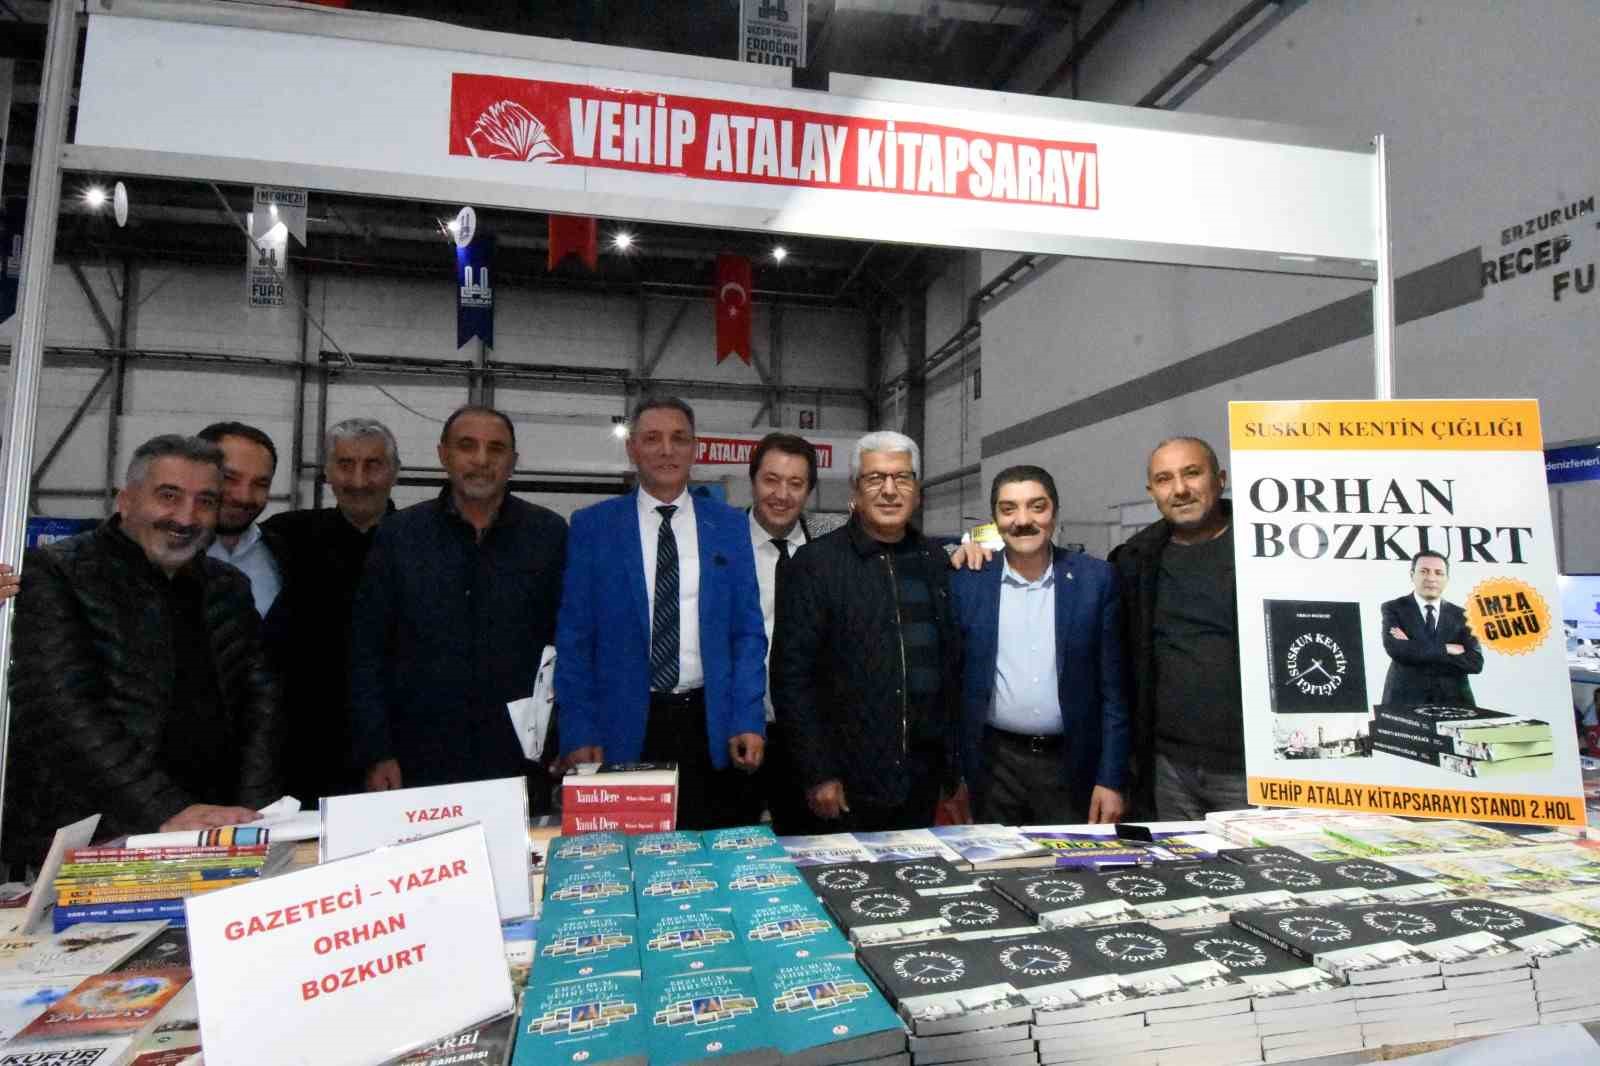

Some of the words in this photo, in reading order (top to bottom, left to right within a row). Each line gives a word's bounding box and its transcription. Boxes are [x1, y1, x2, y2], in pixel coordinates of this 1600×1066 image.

[569, 96, 696, 168] VEHİP
[704, 112, 848, 184] ATALAY
[857, 119, 1097, 208] KİTAPSARAYI
[1501, 195, 1594, 246] ERZURUM
[1480, 234, 1572, 288] RECEP
[1244, 420, 1332, 437] SUSKUN
[1339, 416, 1424, 437] KENTİN
[1431, 417, 1524, 440] ÇIĞLIĞI
[709, 443, 751, 462] ATALAY
[1249, 477, 1456, 515] ORHAN
[1250, 522, 1534, 564] BOZKURT
[1476, 592, 1531, 617] İMZA
[1483, 611, 1541, 640] GÜNÜ
[1287, 632, 1313, 677] SUSKUN
[1315, 633, 1348, 674] KENTİN
[406, 805, 463, 823] YAZAR
[1260, 780, 1302, 804] VEHİP
[1307, 785, 1363, 807] ATALAY
[1368, 785, 1468, 814] KİTAPSARAYI
[1472, 797, 1526, 818] STANDI
[1530, 800, 1576, 821] 2.HOL
[224, 884, 363, 941] GAZETECİ
[388, 859, 468, 895] YAZAR
[313, 913, 406, 955] ORHAN
[301, 943, 427, 1001] BOZKURT
[4, 1048, 100, 1064] KÜFÜR
